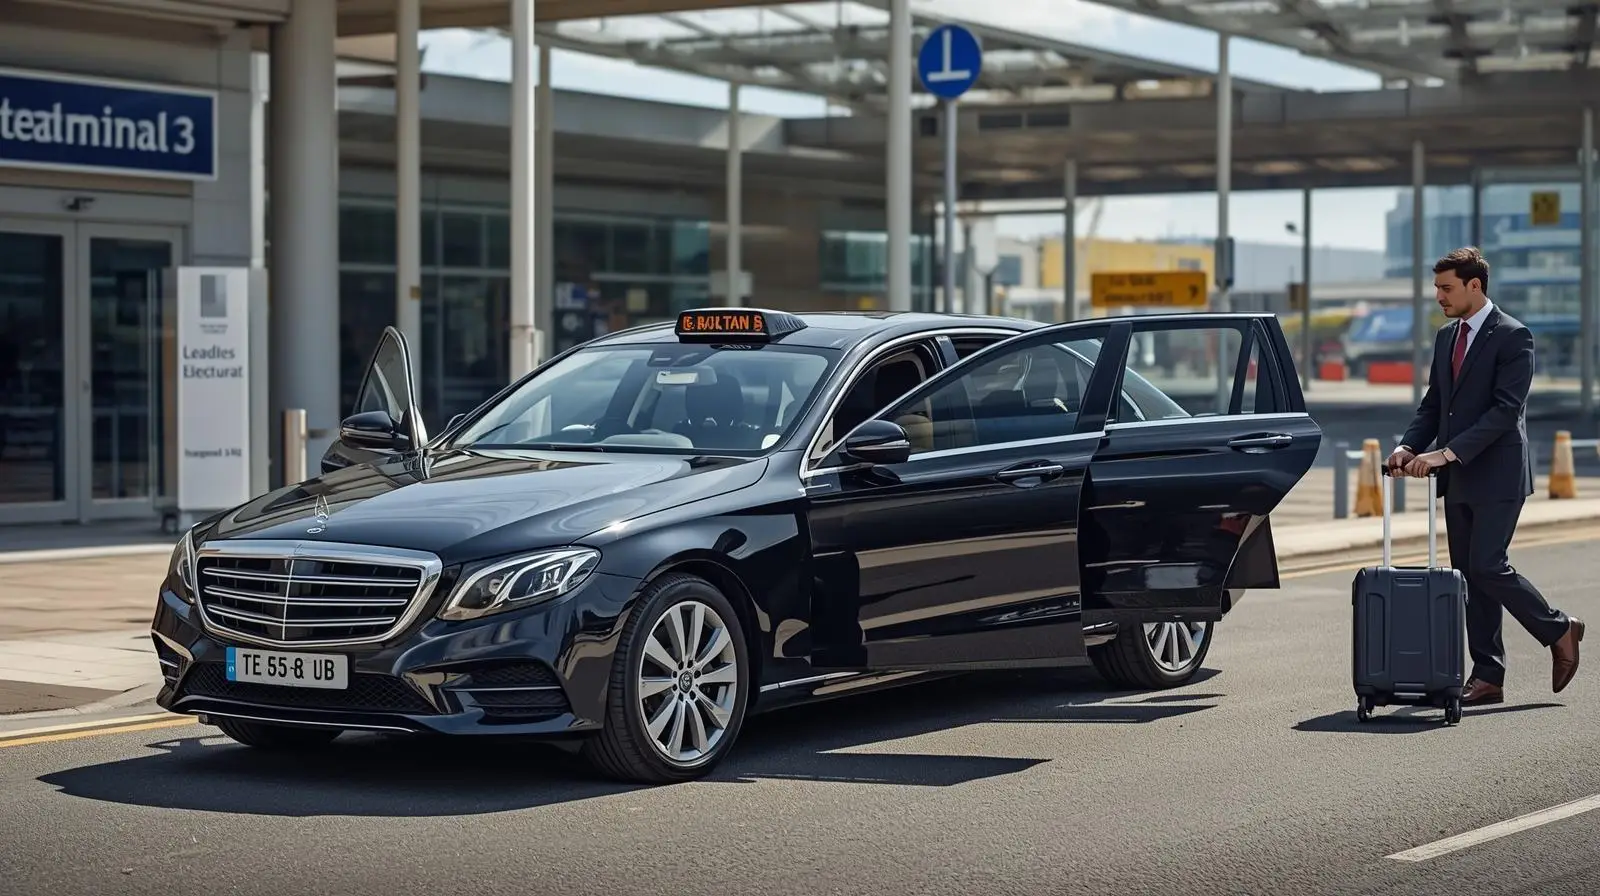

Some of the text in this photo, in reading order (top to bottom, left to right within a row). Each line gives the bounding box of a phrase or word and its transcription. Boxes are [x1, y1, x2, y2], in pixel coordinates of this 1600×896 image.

[173, 115, 195, 154] 3
[242, 654, 262, 676] TE
[313, 659, 335, 680] UB
